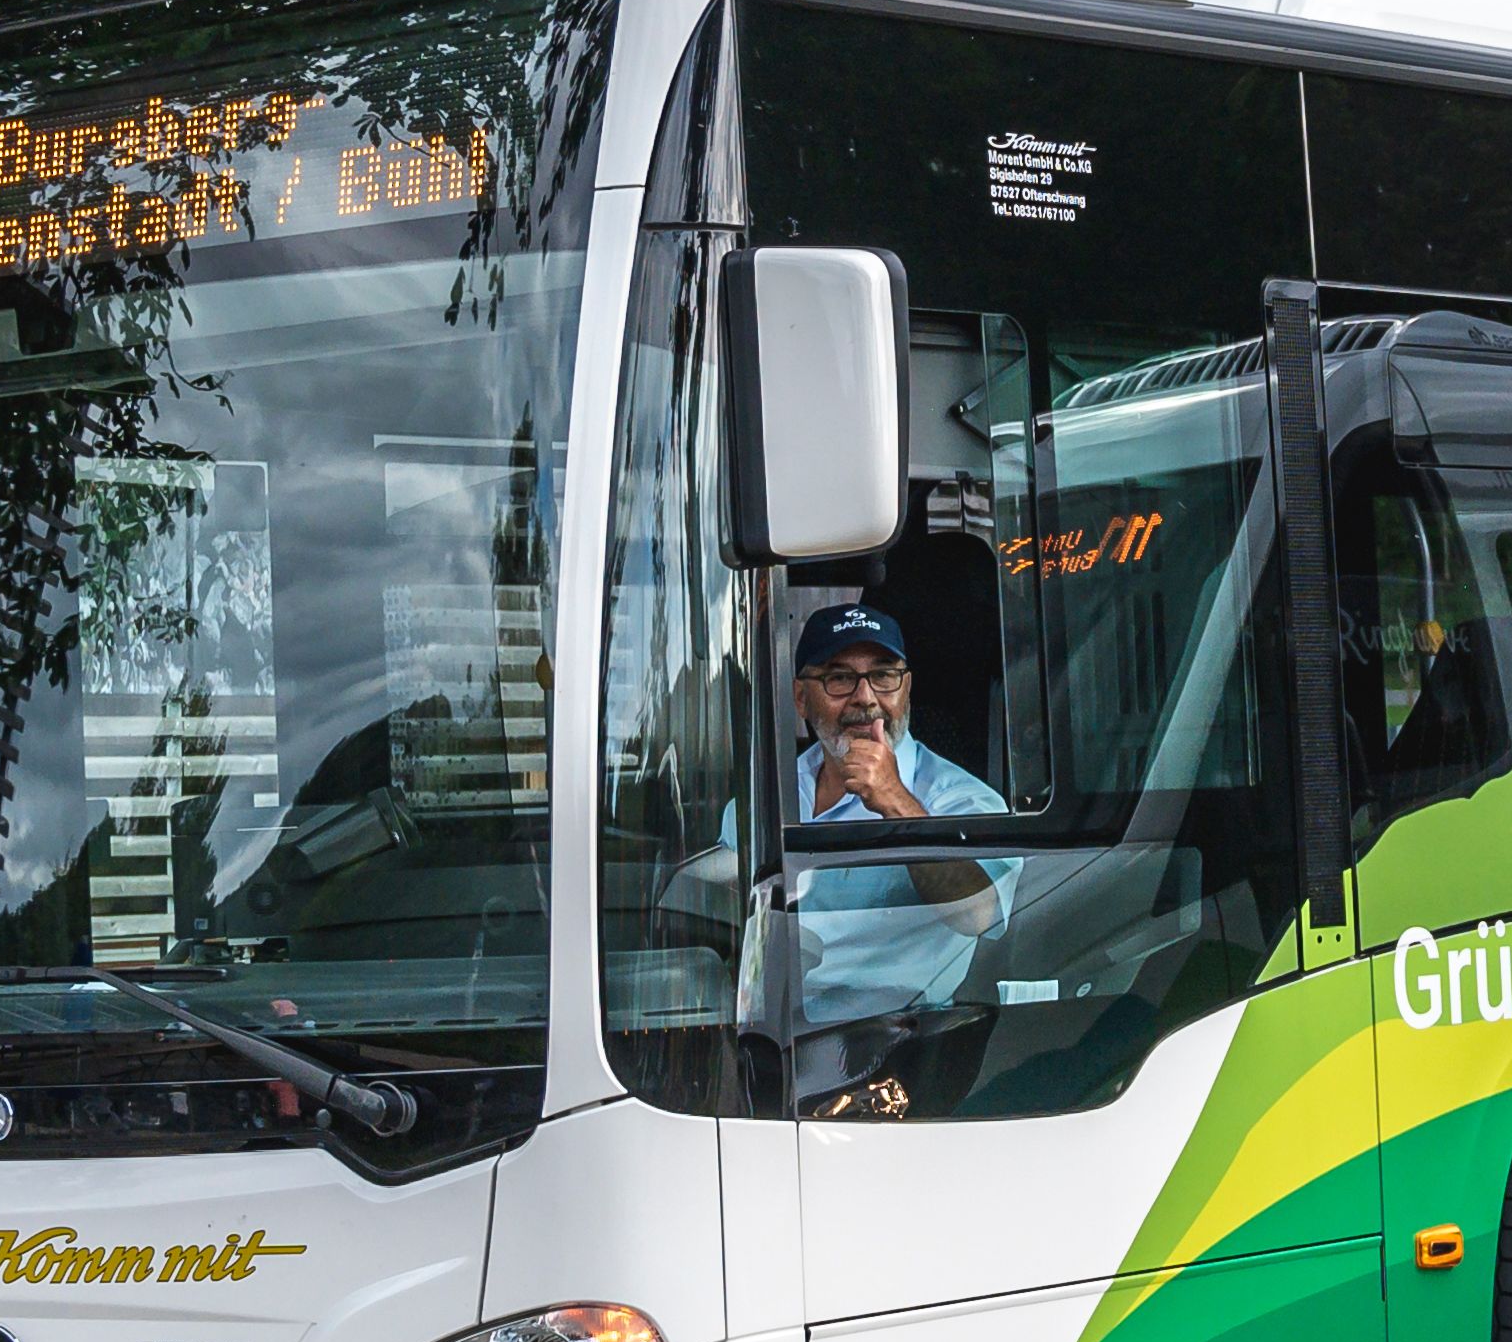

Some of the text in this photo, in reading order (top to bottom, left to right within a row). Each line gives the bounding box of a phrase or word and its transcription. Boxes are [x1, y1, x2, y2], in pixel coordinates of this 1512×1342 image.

[988, 149, 1023, 167] Morent
[1024, 154, 1054, 170] GmbH
[1055, 157, 1062, 170] &
[276, 156, 301, 225] /
[337, 127, 489, 217] Bühl
[989, 167, 1052, 185] Sigishofen 29
[990, 185, 1086, 208] 87527 Ofterschwang
[1013, 204, 1076, 222] 08321/67100
[832, 619, 881, 633] SACHS
[156, 1229, 308, 1284] mit
